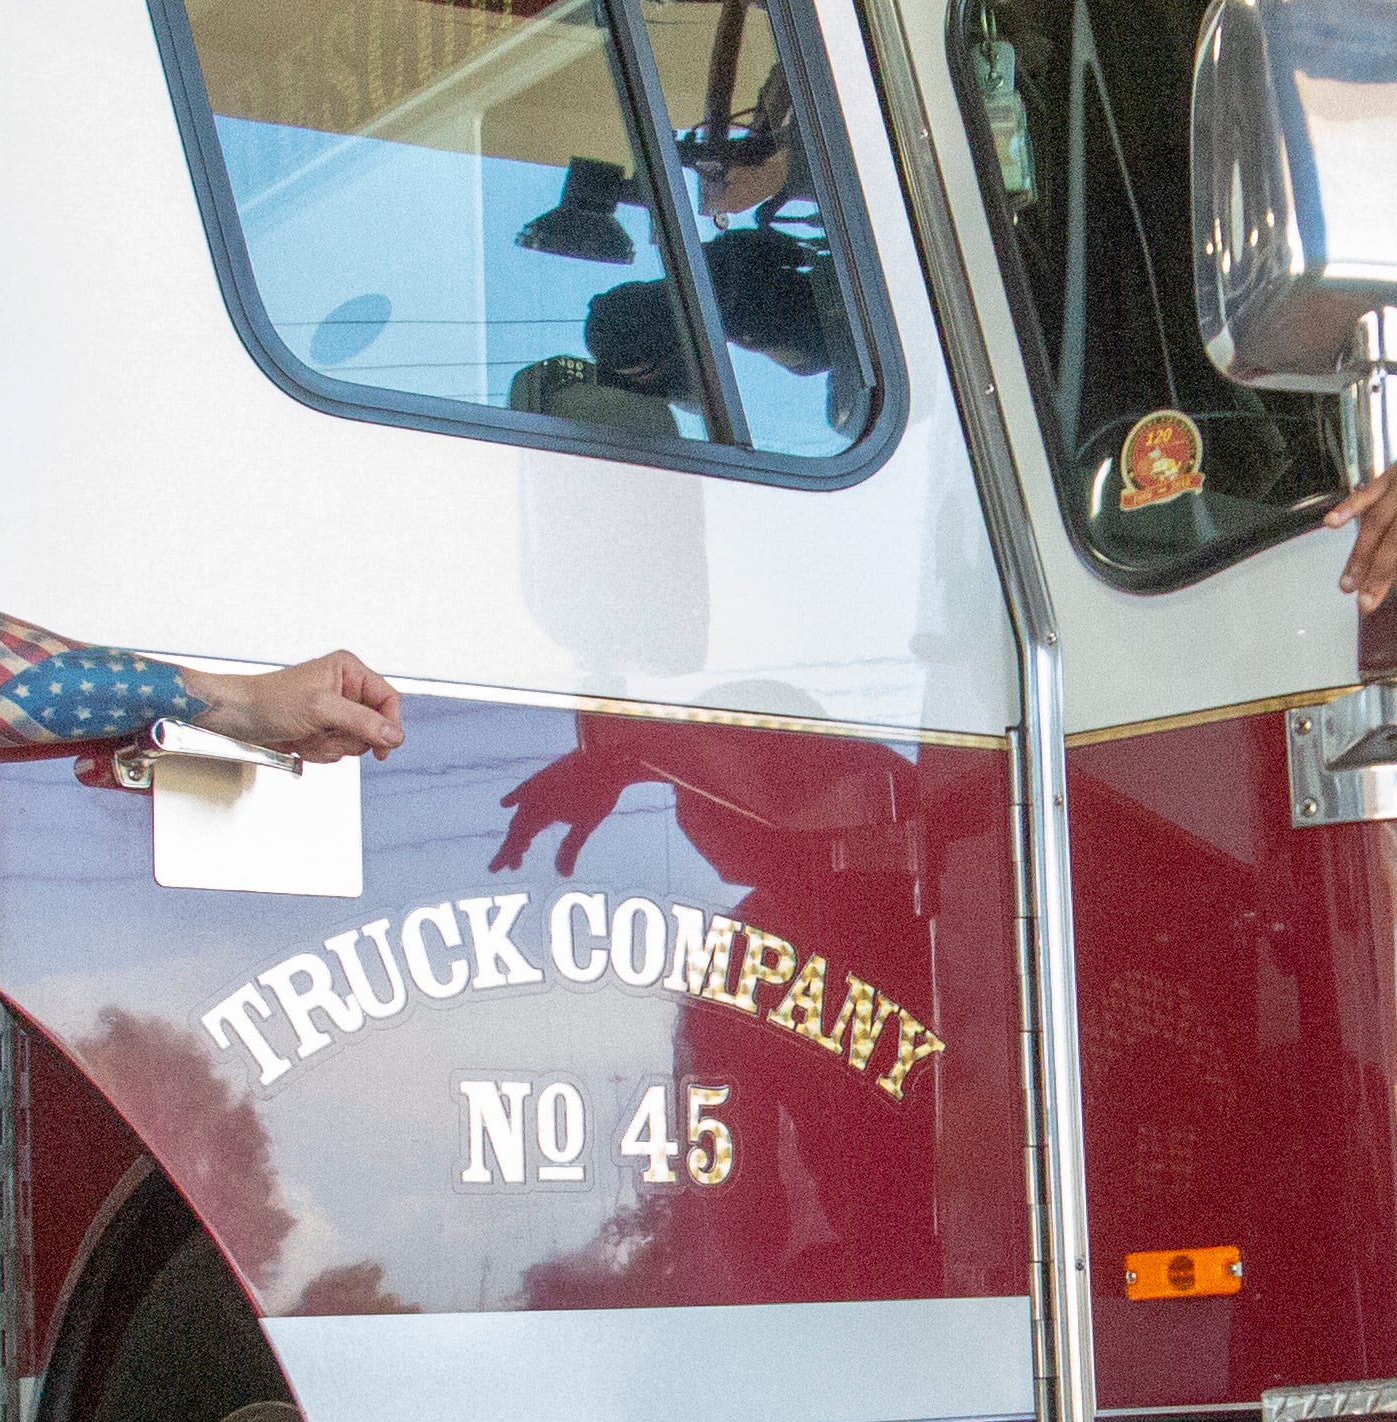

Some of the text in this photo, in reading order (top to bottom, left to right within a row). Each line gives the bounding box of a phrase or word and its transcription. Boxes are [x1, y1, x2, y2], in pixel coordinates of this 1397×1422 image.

[201, 891, 946, 1101] TRUCK COMPANY
[620, 1084, 733, 1185] 45
